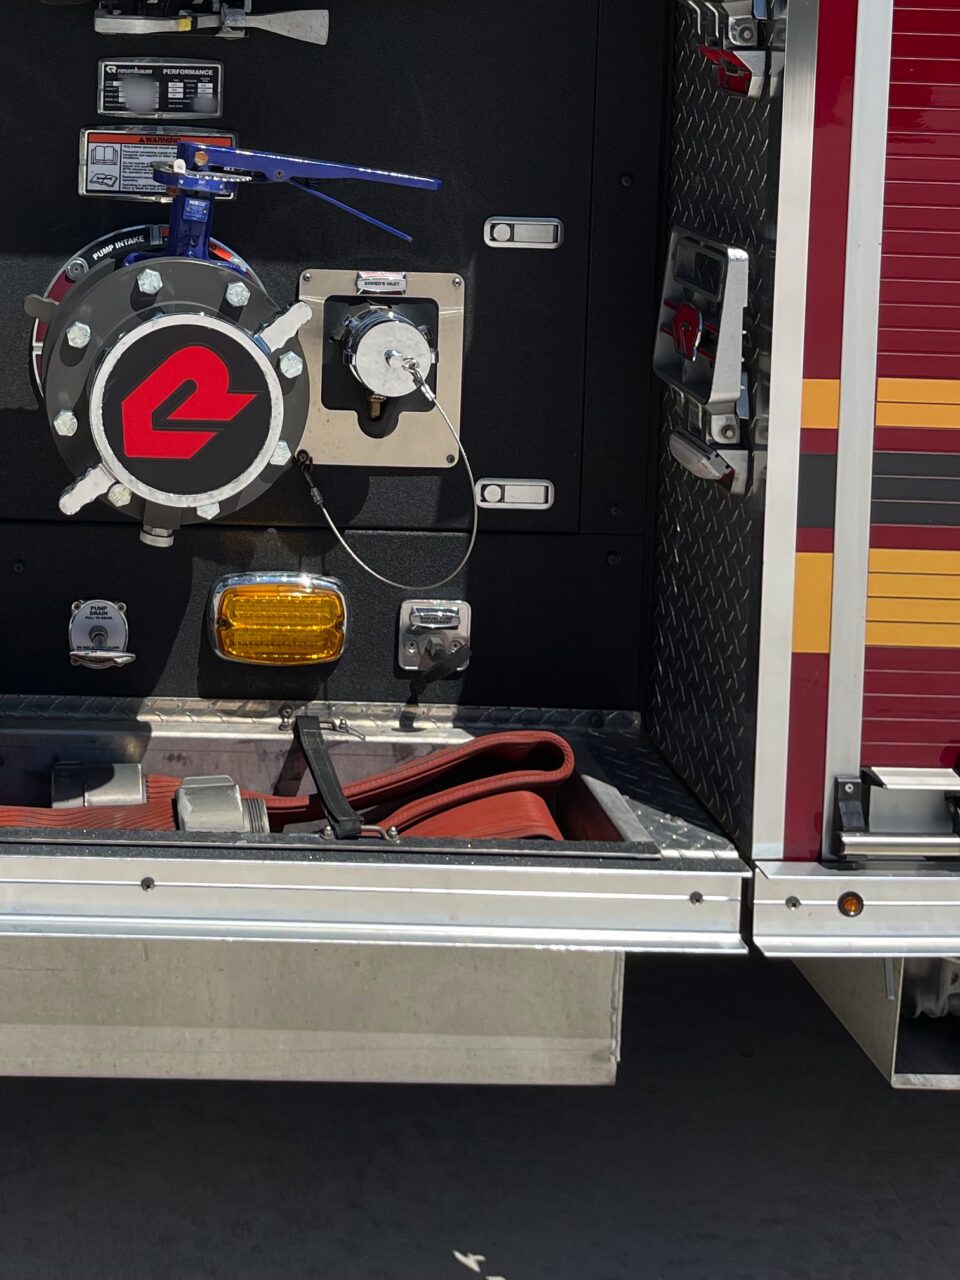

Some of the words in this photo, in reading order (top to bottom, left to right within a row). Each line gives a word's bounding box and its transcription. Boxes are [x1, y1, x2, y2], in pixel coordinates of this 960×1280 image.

[162, 68, 214, 76] PERFORMANCE
[145, 136, 181, 144] WARNING
[92, 243, 115, 261] PUMP
[114, 235, 145, 250] INTAKE
